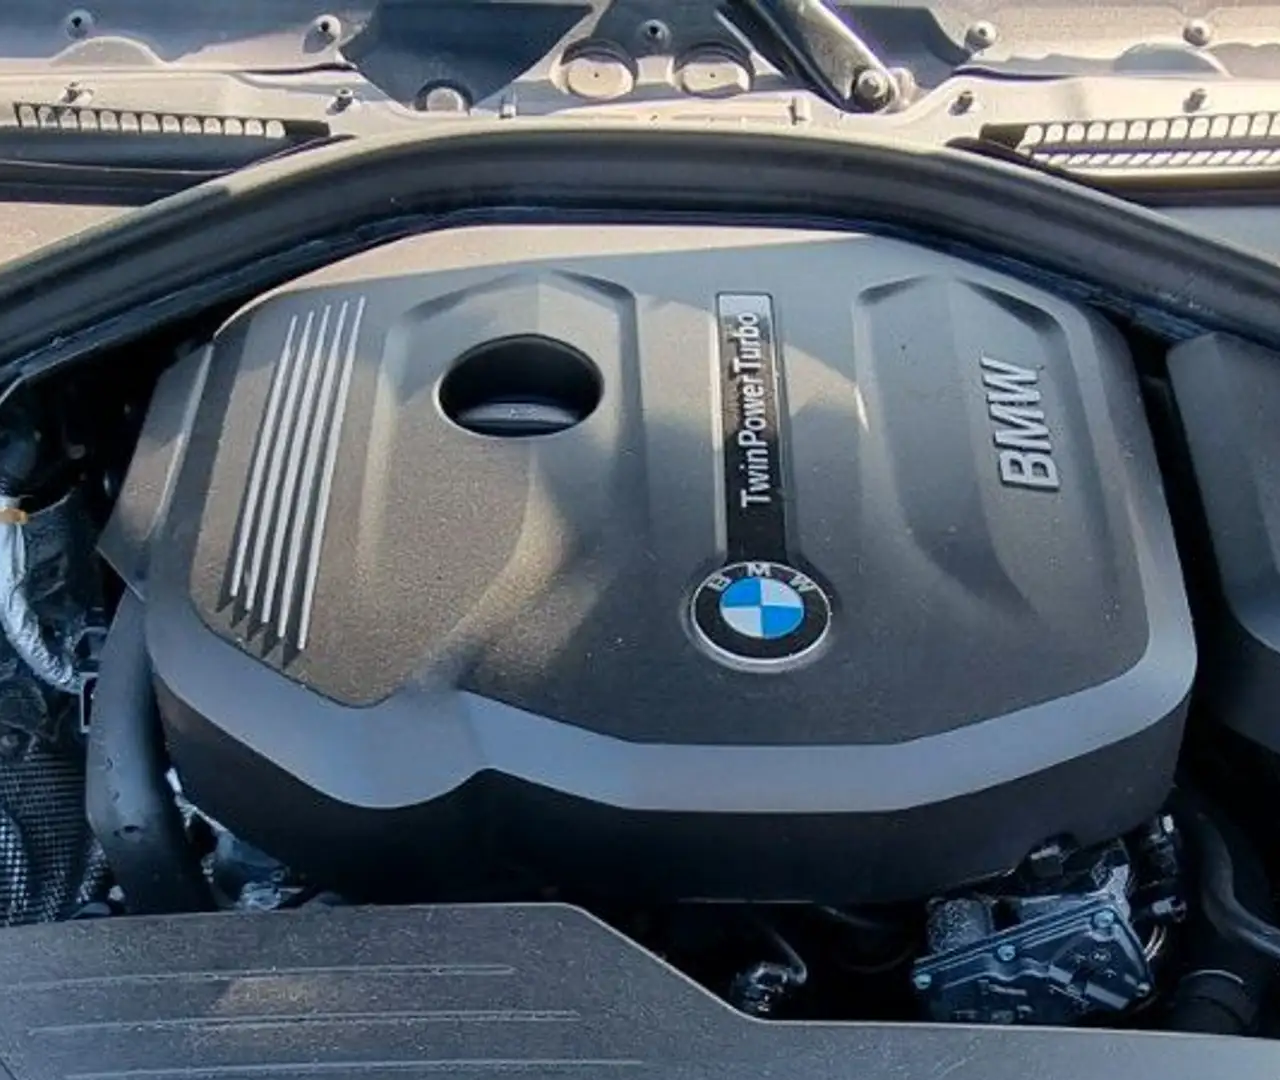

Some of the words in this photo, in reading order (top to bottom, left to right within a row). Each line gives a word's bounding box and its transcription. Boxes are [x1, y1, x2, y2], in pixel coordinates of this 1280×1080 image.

[731, 311, 763, 373] Turbo
[737, 374, 773, 508] TwinPower
[979, 354, 1061, 491] BMW
[705, 561, 818, 592] BMW
